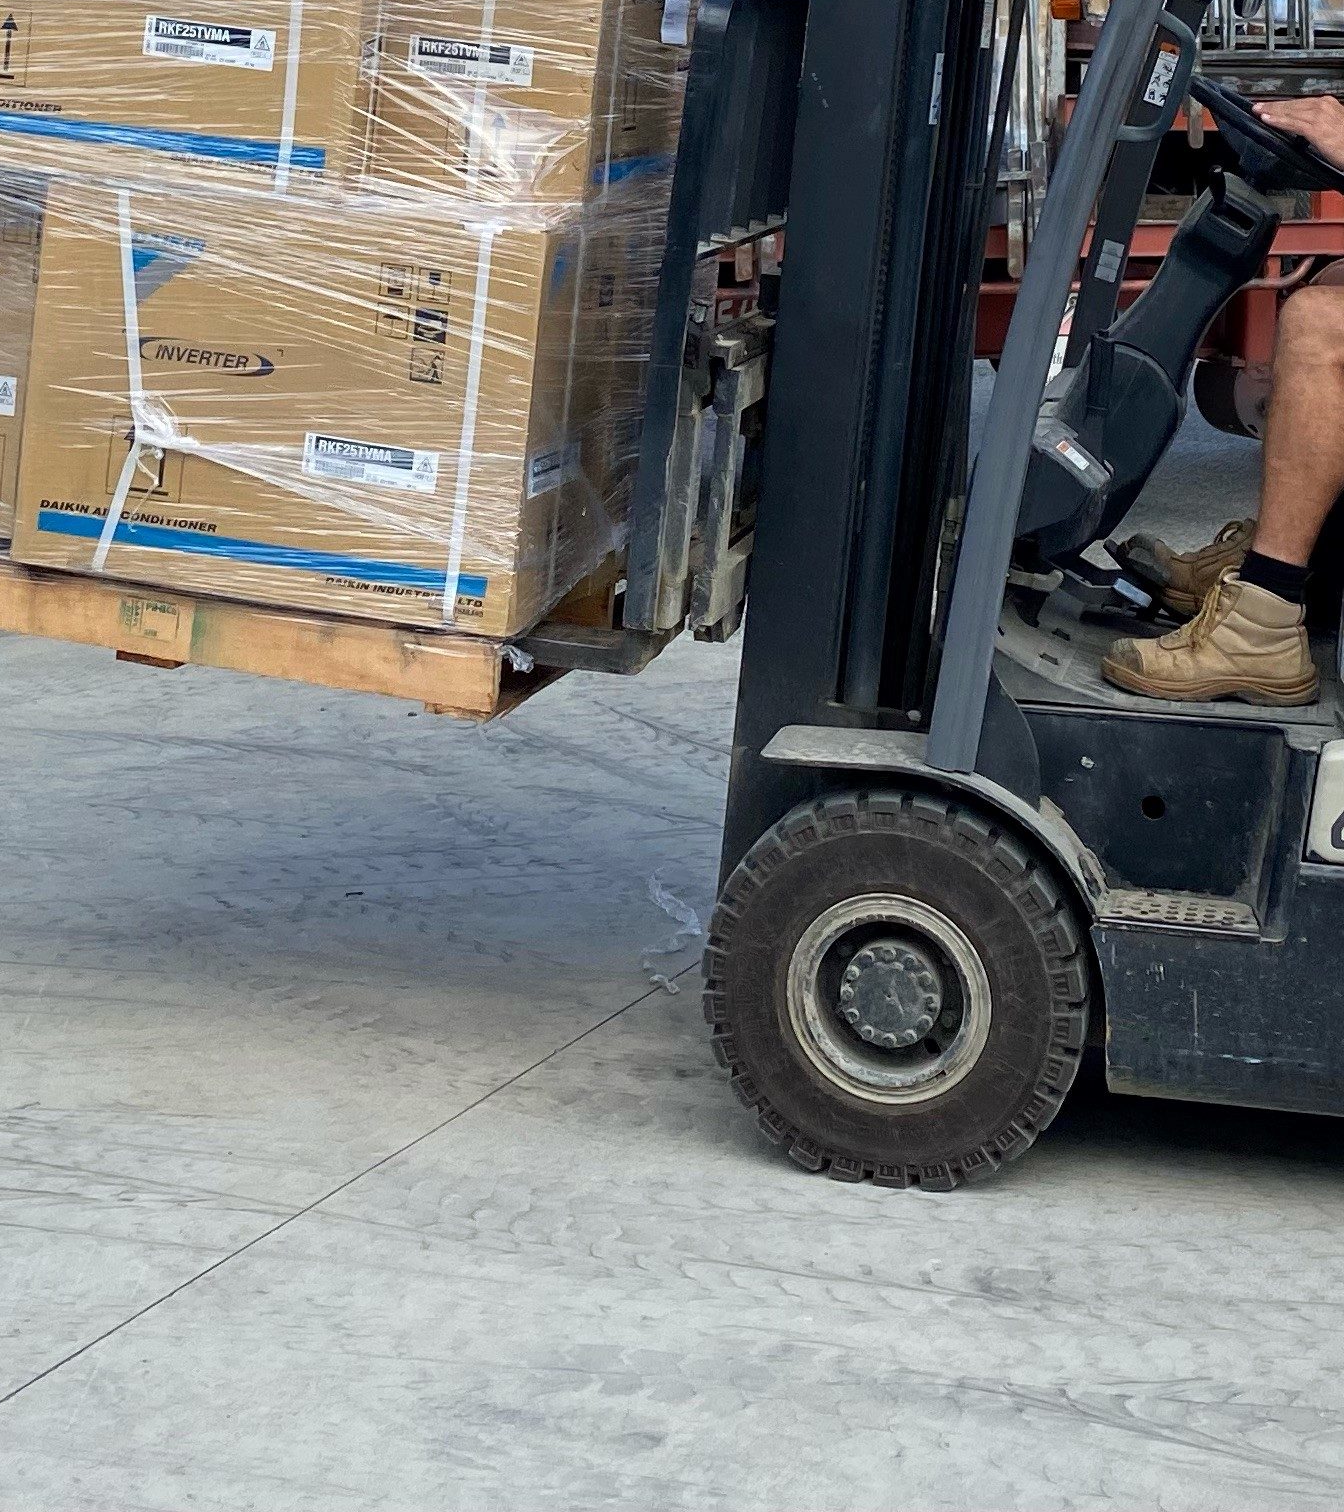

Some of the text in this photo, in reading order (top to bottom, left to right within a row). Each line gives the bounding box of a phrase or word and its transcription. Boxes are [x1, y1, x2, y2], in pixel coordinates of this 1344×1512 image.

[158, 21, 231, 43] RKF25TVMA
[155, 343, 249, 371] INVERTER
[318, 441, 392, 464] RKF25TVMA
[40, 499, 90, 515] DAIKIN
[118, 509, 218, 533] CONDITIONER
